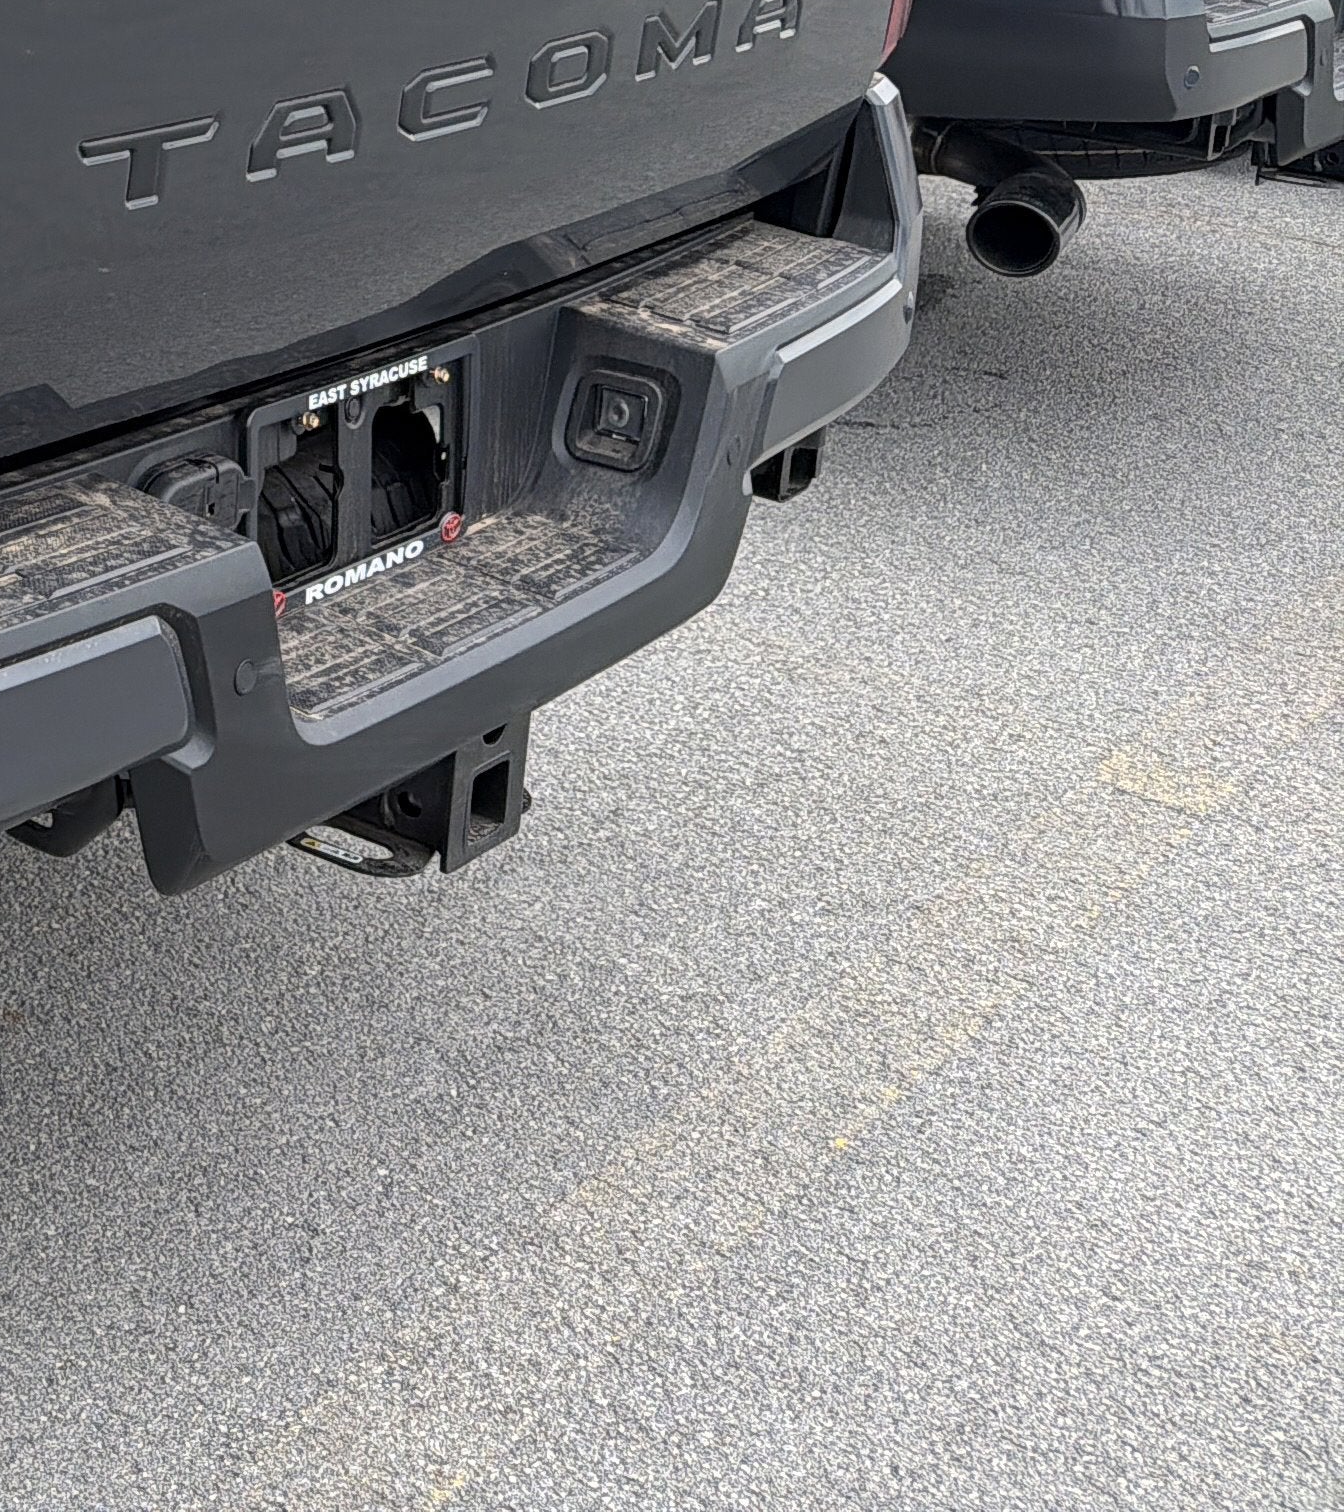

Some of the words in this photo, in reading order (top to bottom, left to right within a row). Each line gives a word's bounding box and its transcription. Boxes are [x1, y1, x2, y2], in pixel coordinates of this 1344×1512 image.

[308, 384, 348, 411] EAST
[349, 355, 428, 396] SYRACUSE
[304, 540, 425, 605] ROMANO
